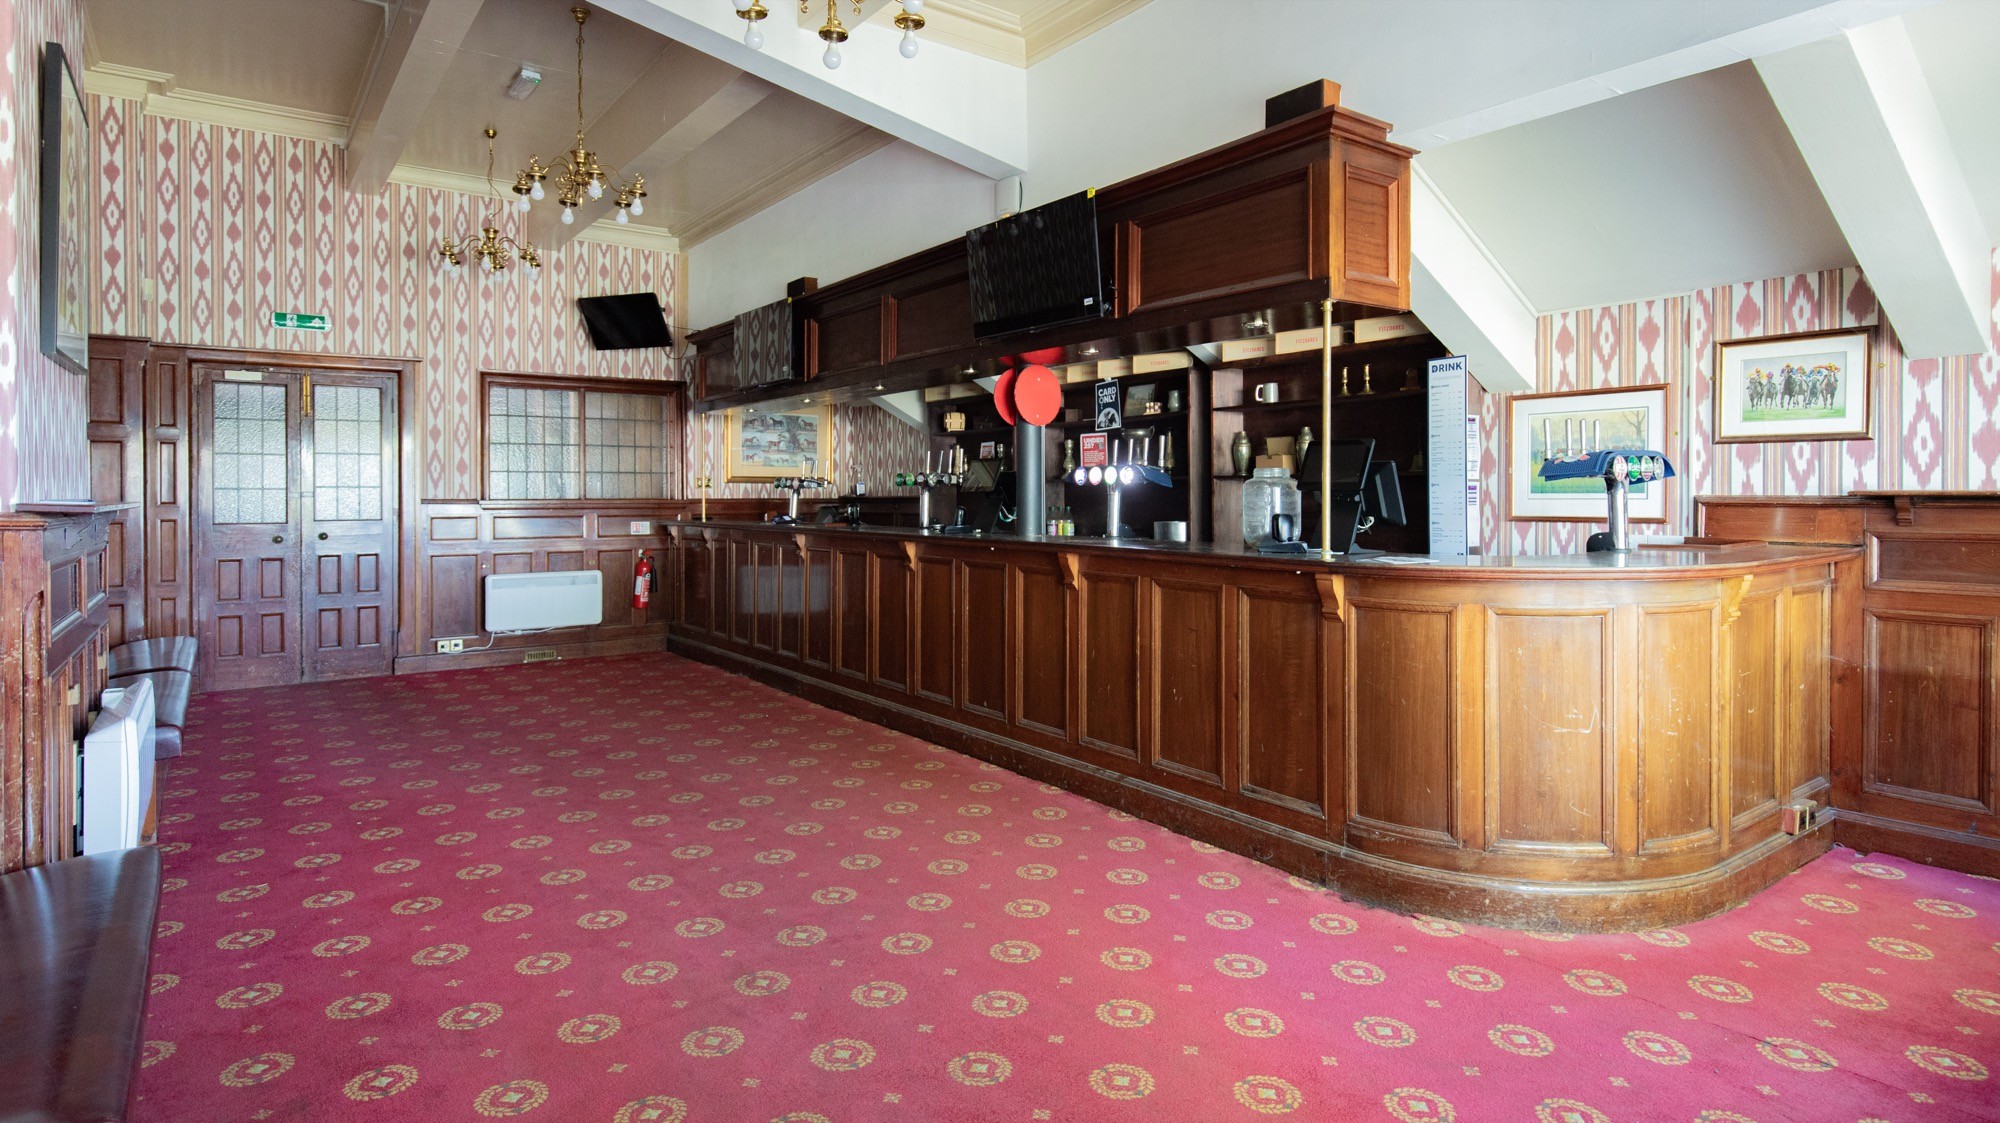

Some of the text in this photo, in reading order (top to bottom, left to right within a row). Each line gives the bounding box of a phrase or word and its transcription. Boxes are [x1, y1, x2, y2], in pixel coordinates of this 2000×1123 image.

[1431, 362, 1463, 373] DRINK
[1098, 386, 1117, 397] CARD
[1098, 394, 1116, 404] ONLY
